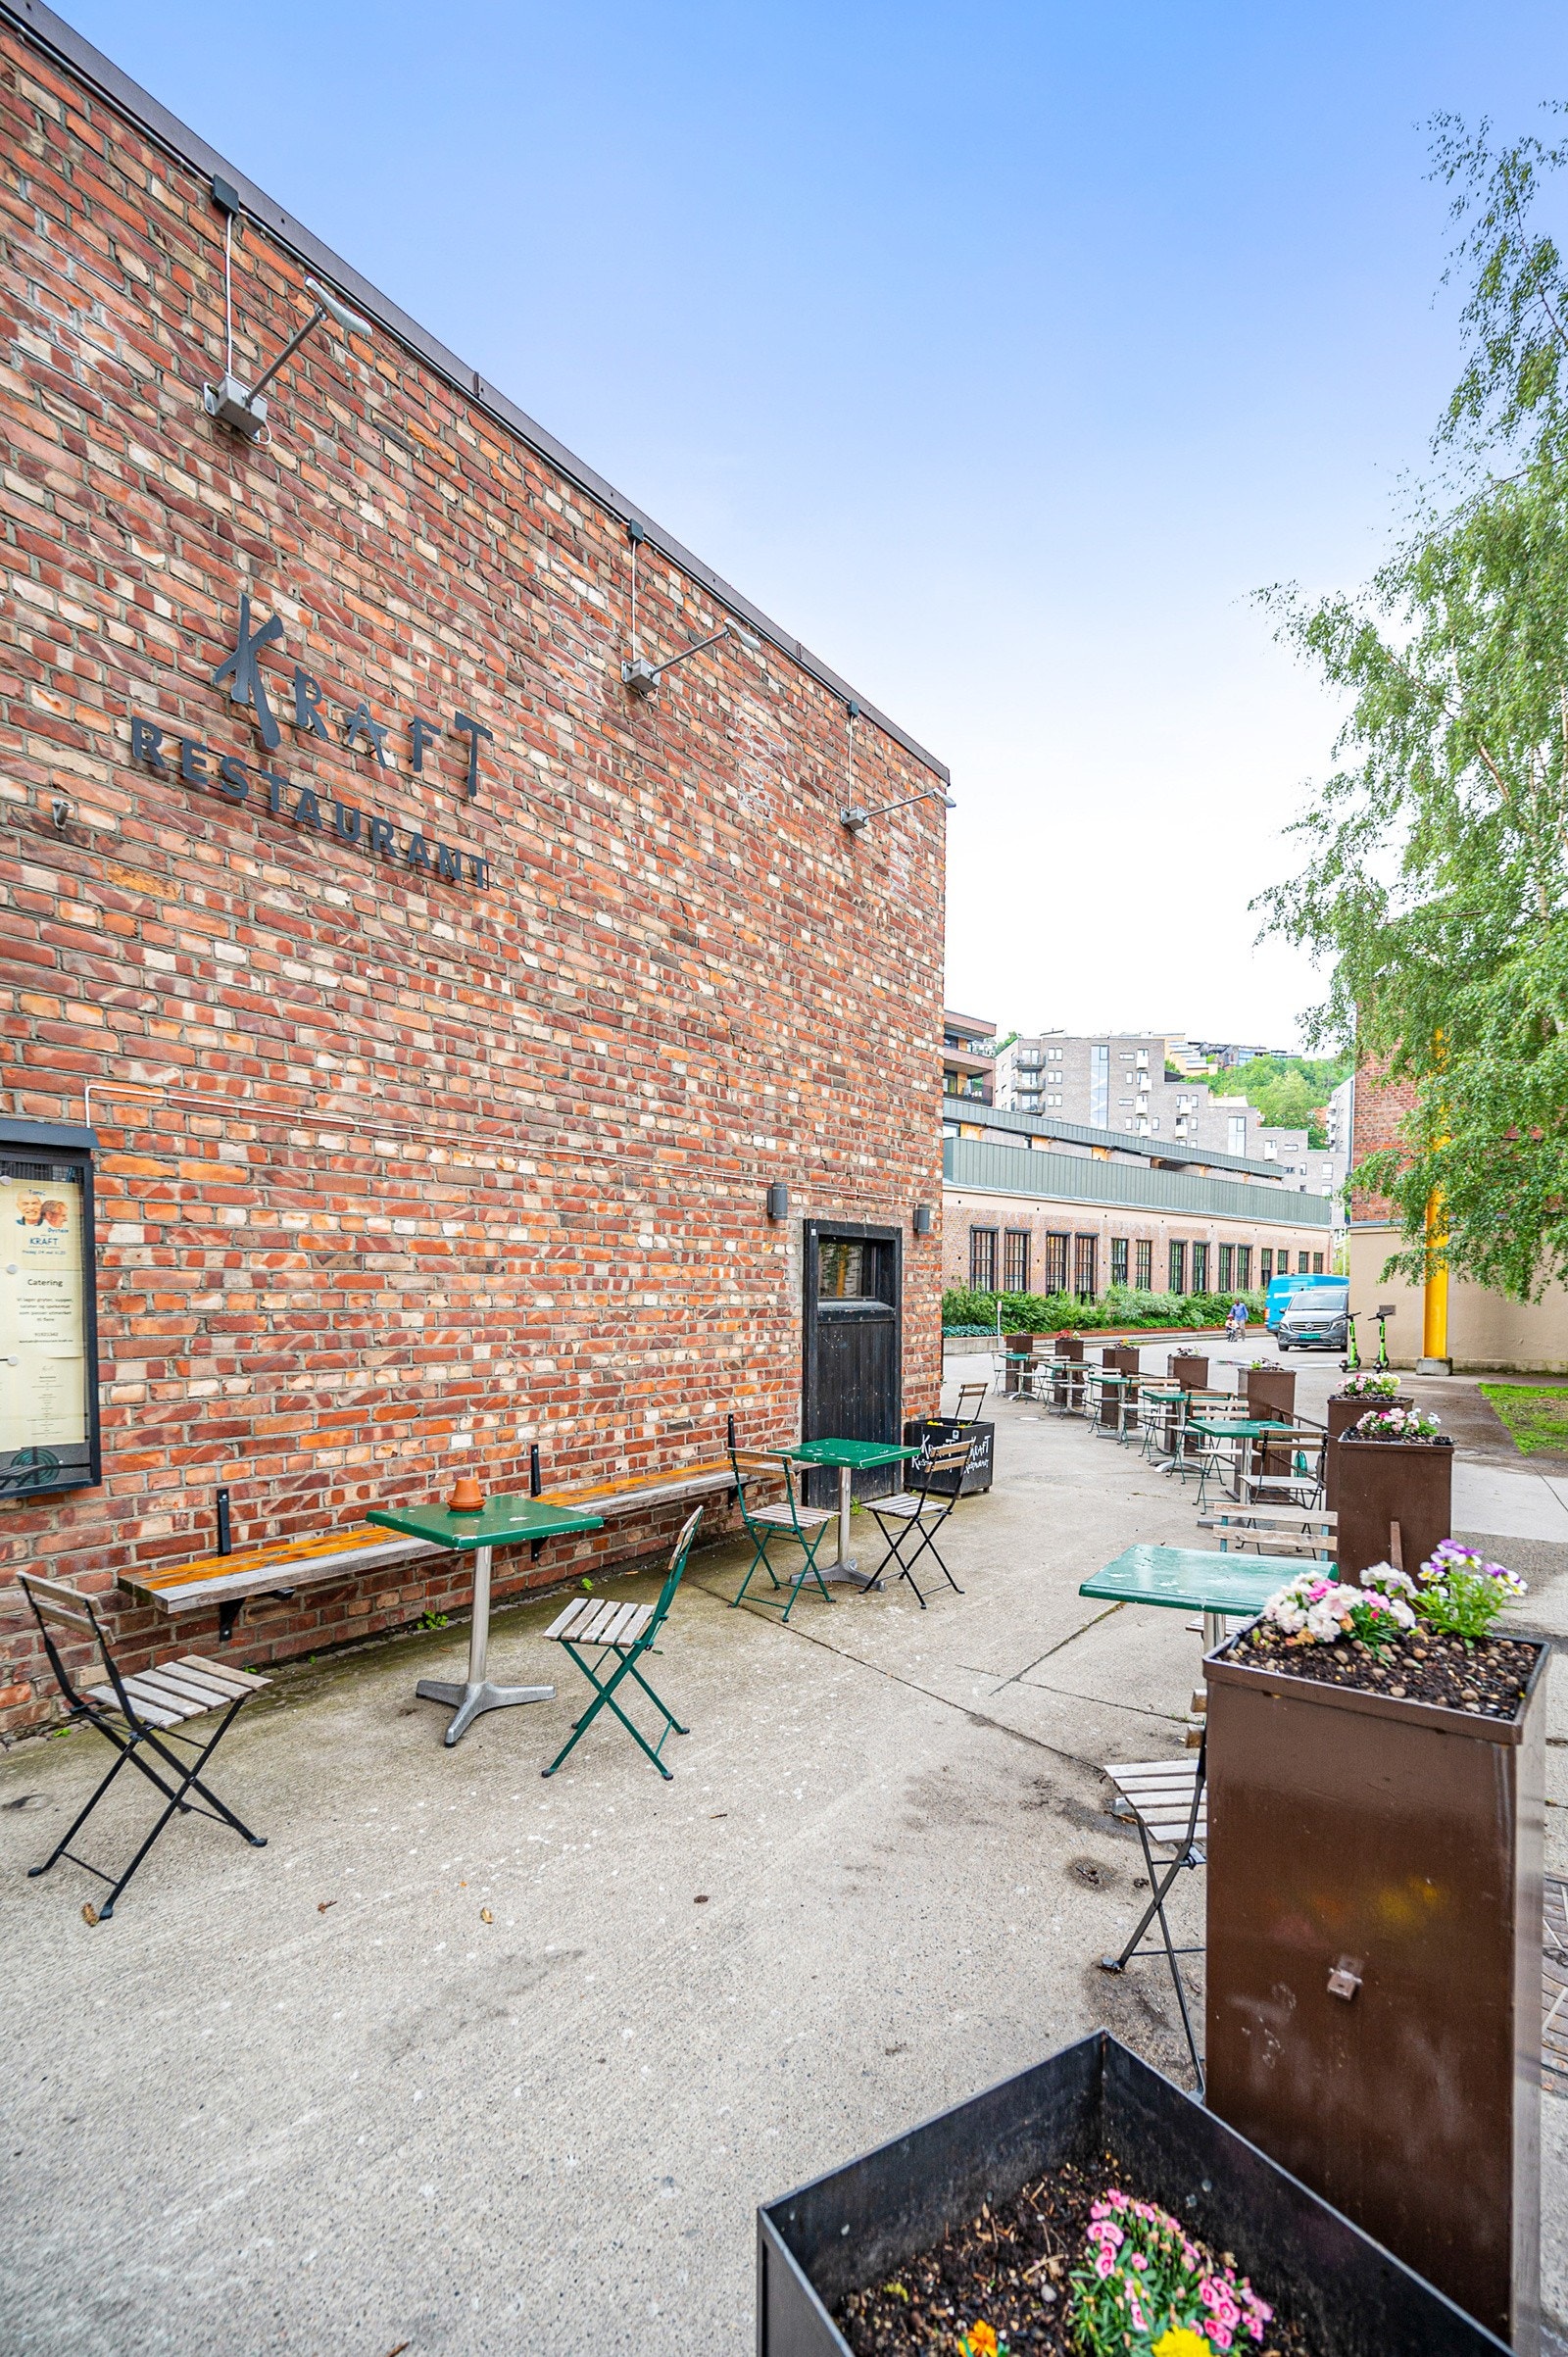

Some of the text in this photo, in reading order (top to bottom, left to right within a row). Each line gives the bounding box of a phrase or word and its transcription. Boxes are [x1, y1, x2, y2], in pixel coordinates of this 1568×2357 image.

[213, 592, 493, 798] KRAFT
[131, 715, 489, 889] RESTAURANT
[27, 1278, 64, 1288] Catering
[29, 1237, 59, 1246] KRAFT
